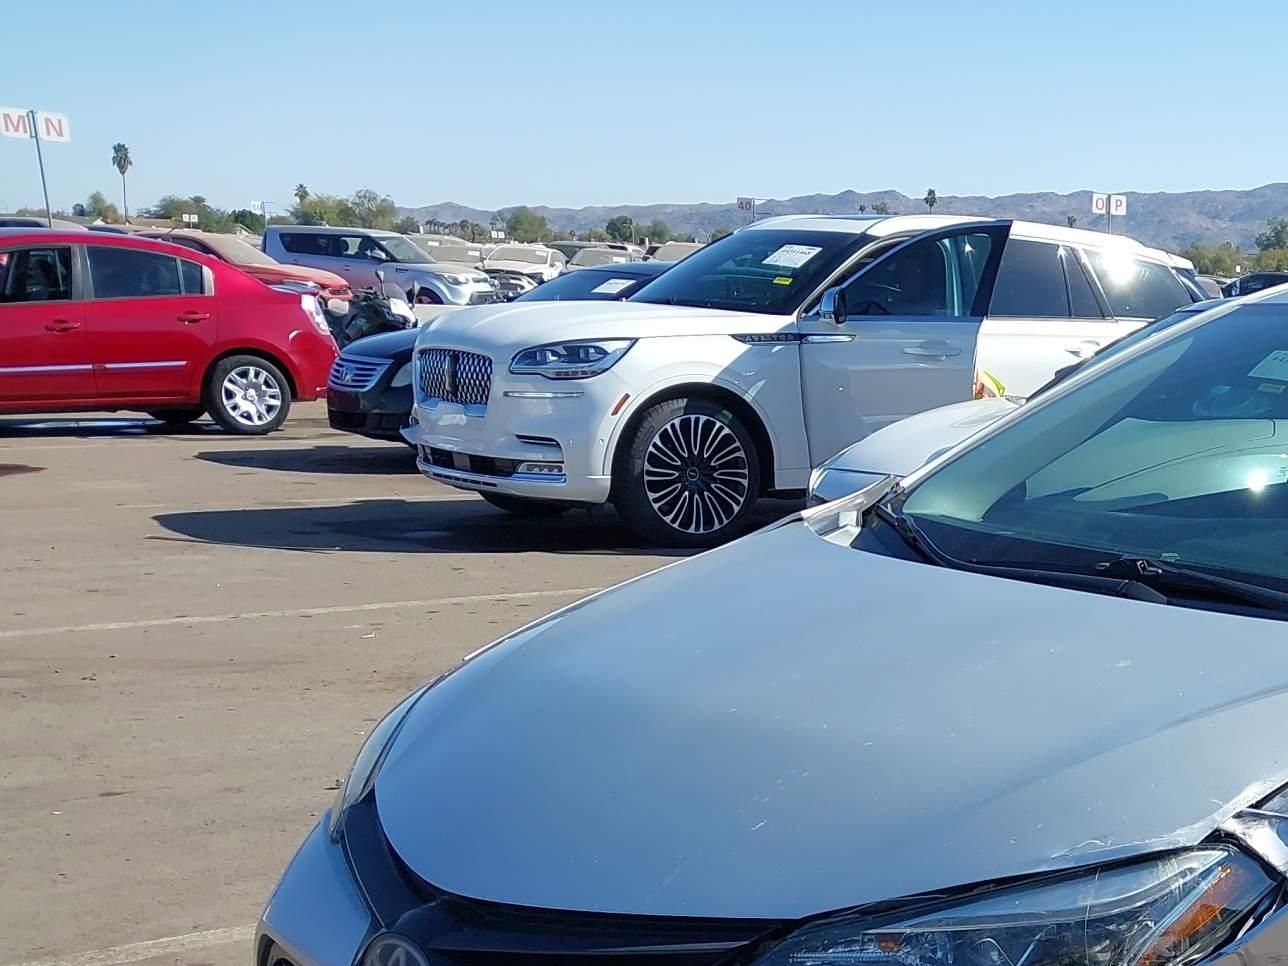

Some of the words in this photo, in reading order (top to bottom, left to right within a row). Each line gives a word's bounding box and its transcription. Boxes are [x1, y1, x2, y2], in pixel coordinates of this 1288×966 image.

[3, 112, 28, 134] M
[44, 116, 64, 138] N
[737, 200, 751, 211] 40
[1115, 199, 1123, 212] P
